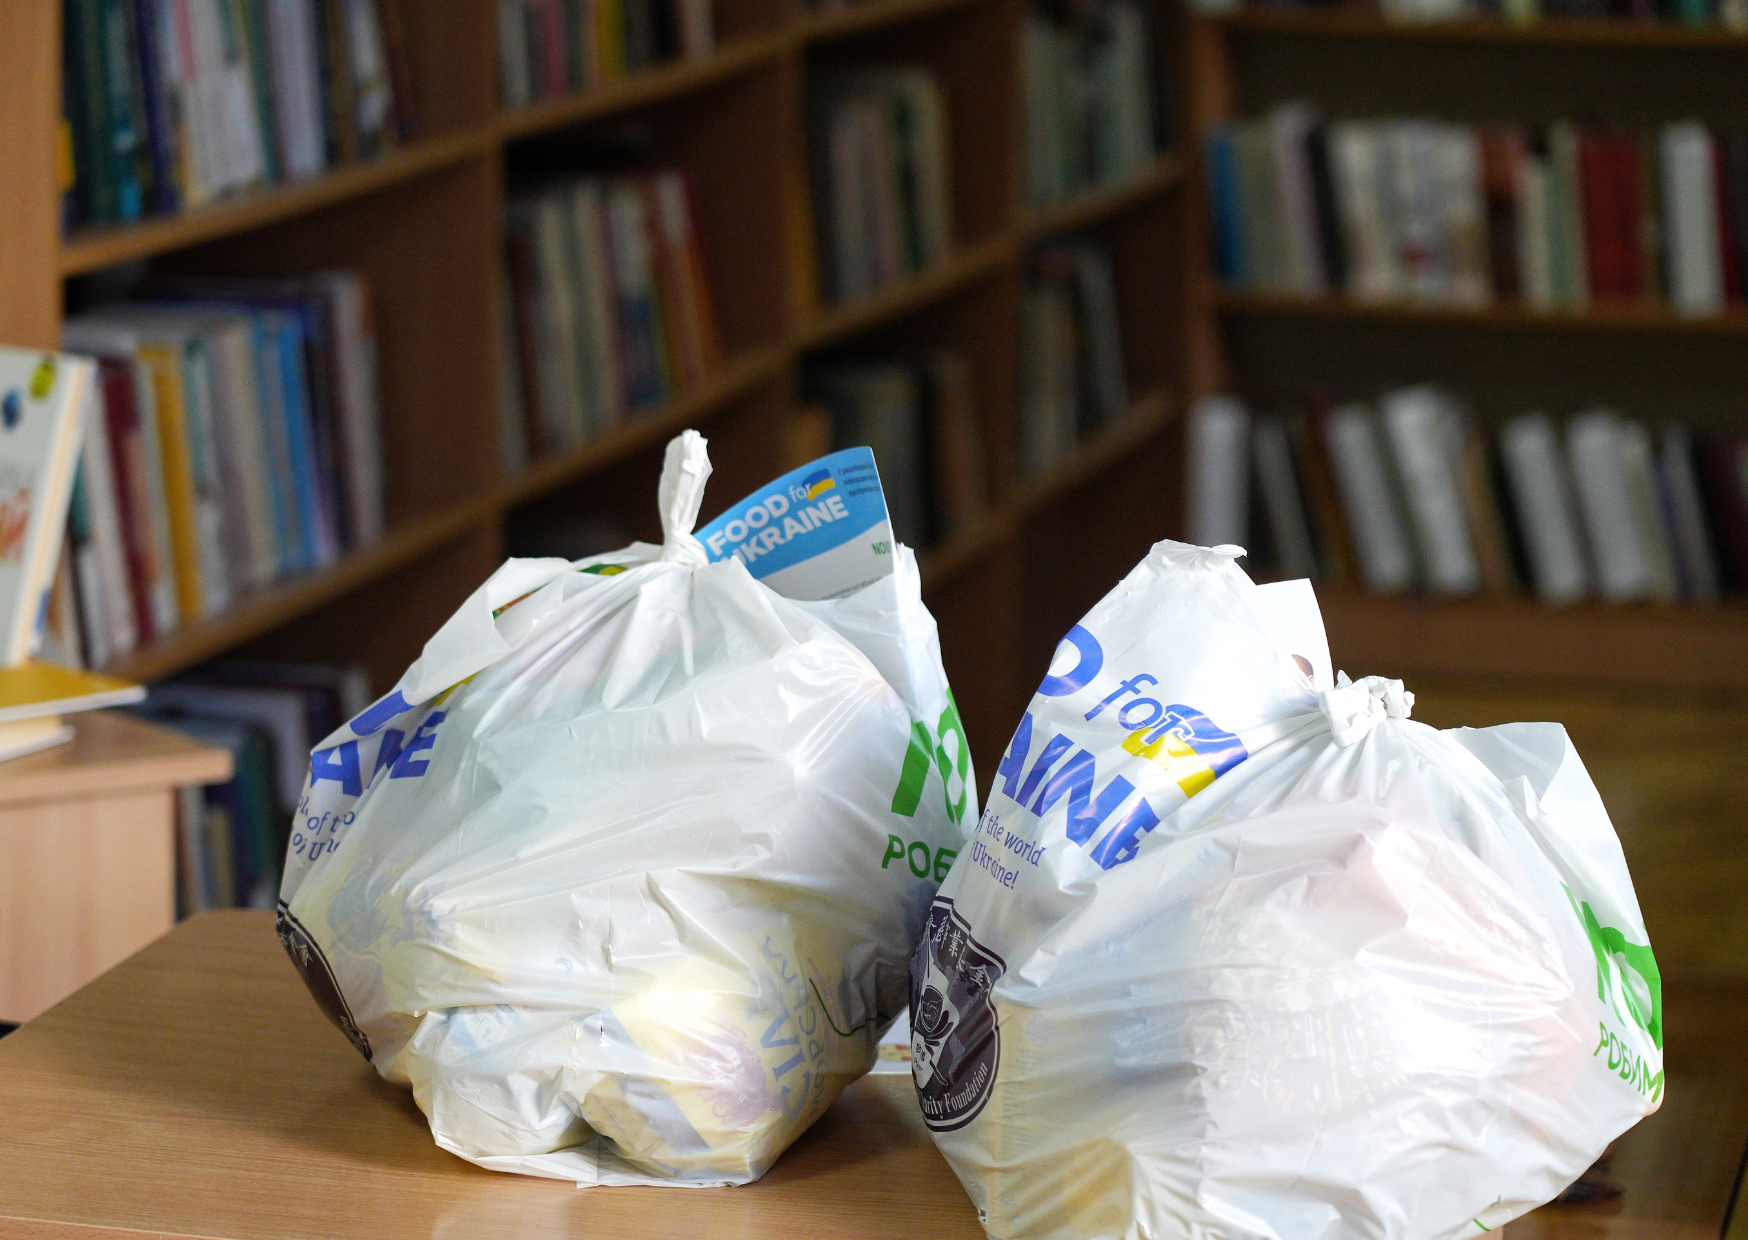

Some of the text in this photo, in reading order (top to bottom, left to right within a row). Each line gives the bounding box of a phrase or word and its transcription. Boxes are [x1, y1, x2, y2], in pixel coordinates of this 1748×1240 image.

[706, 483, 812, 556] FOOD for
[1084, 673, 1195, 746] for
[986, 815, 1005, 842] the
[1004, 831, 1047, 867] world
[943, 1062, 989, 1113] Foundation
